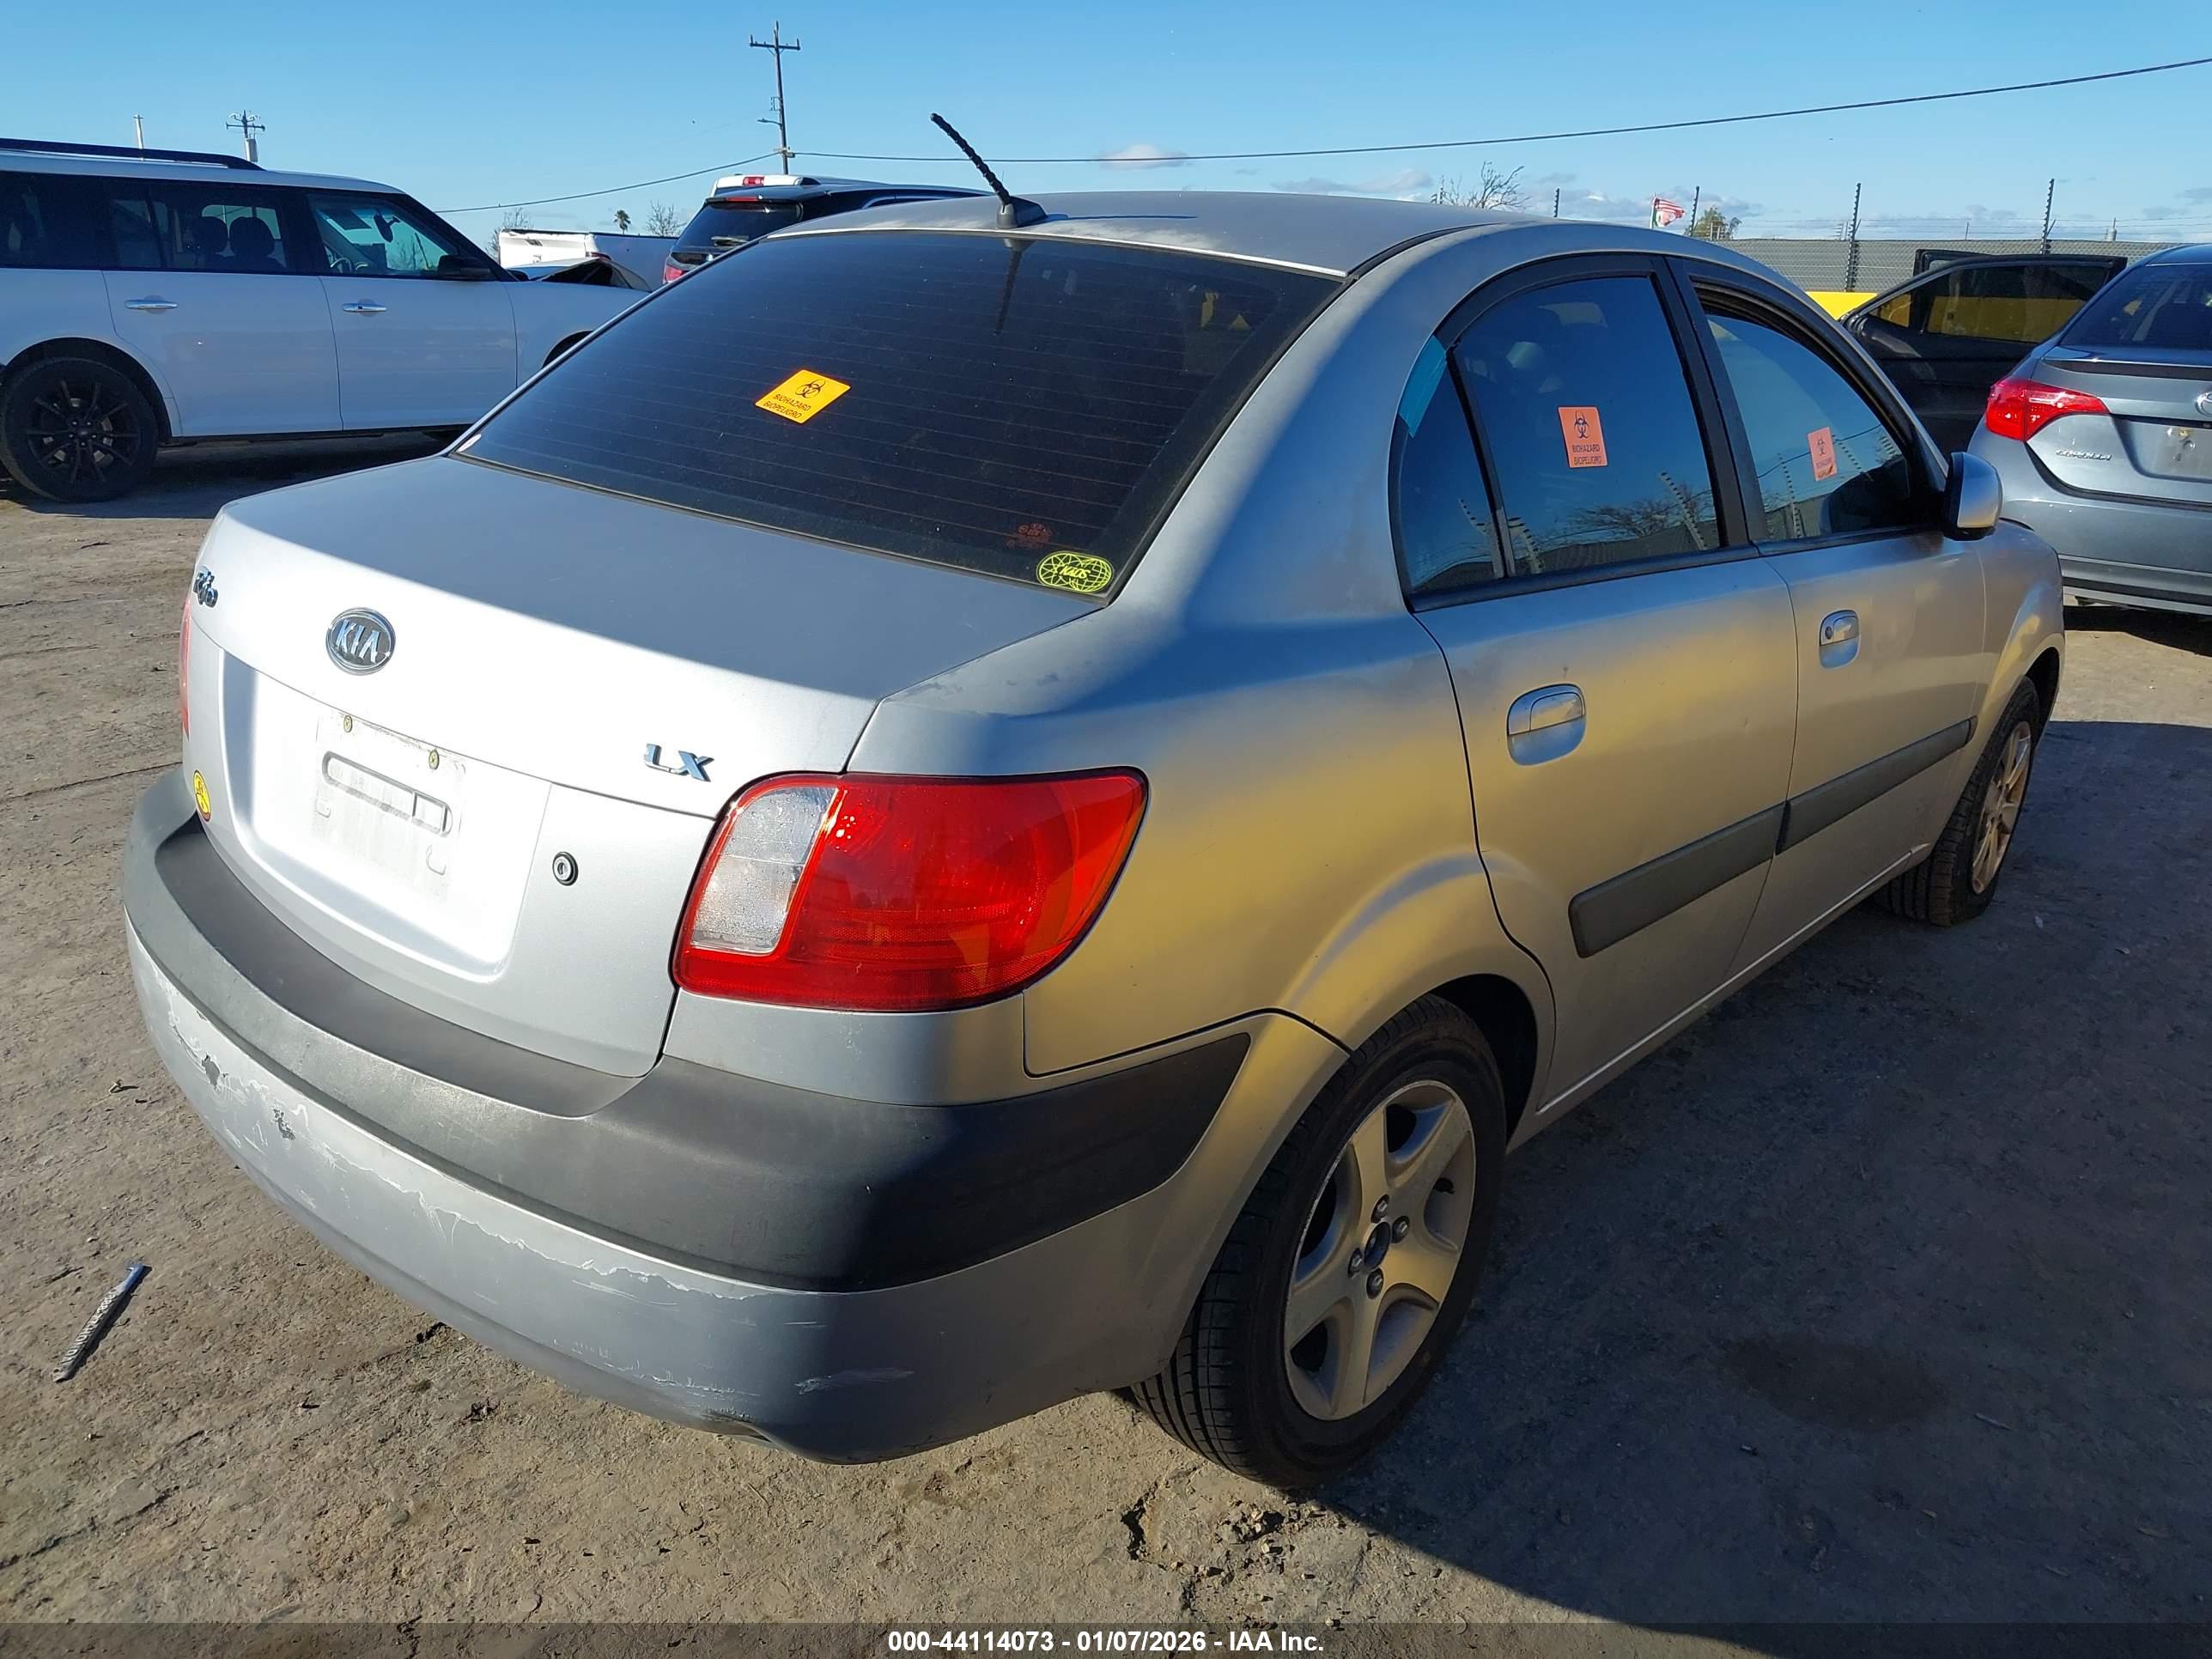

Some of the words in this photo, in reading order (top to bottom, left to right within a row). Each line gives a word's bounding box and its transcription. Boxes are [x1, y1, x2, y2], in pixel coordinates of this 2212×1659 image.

[773, 393, 811, 411] BIOHAZARD
[1571, 444, 1601, 453] BIOHAZARD
[336, 619, 380, 664] KIA
[644, 743, 714, 782] LX
